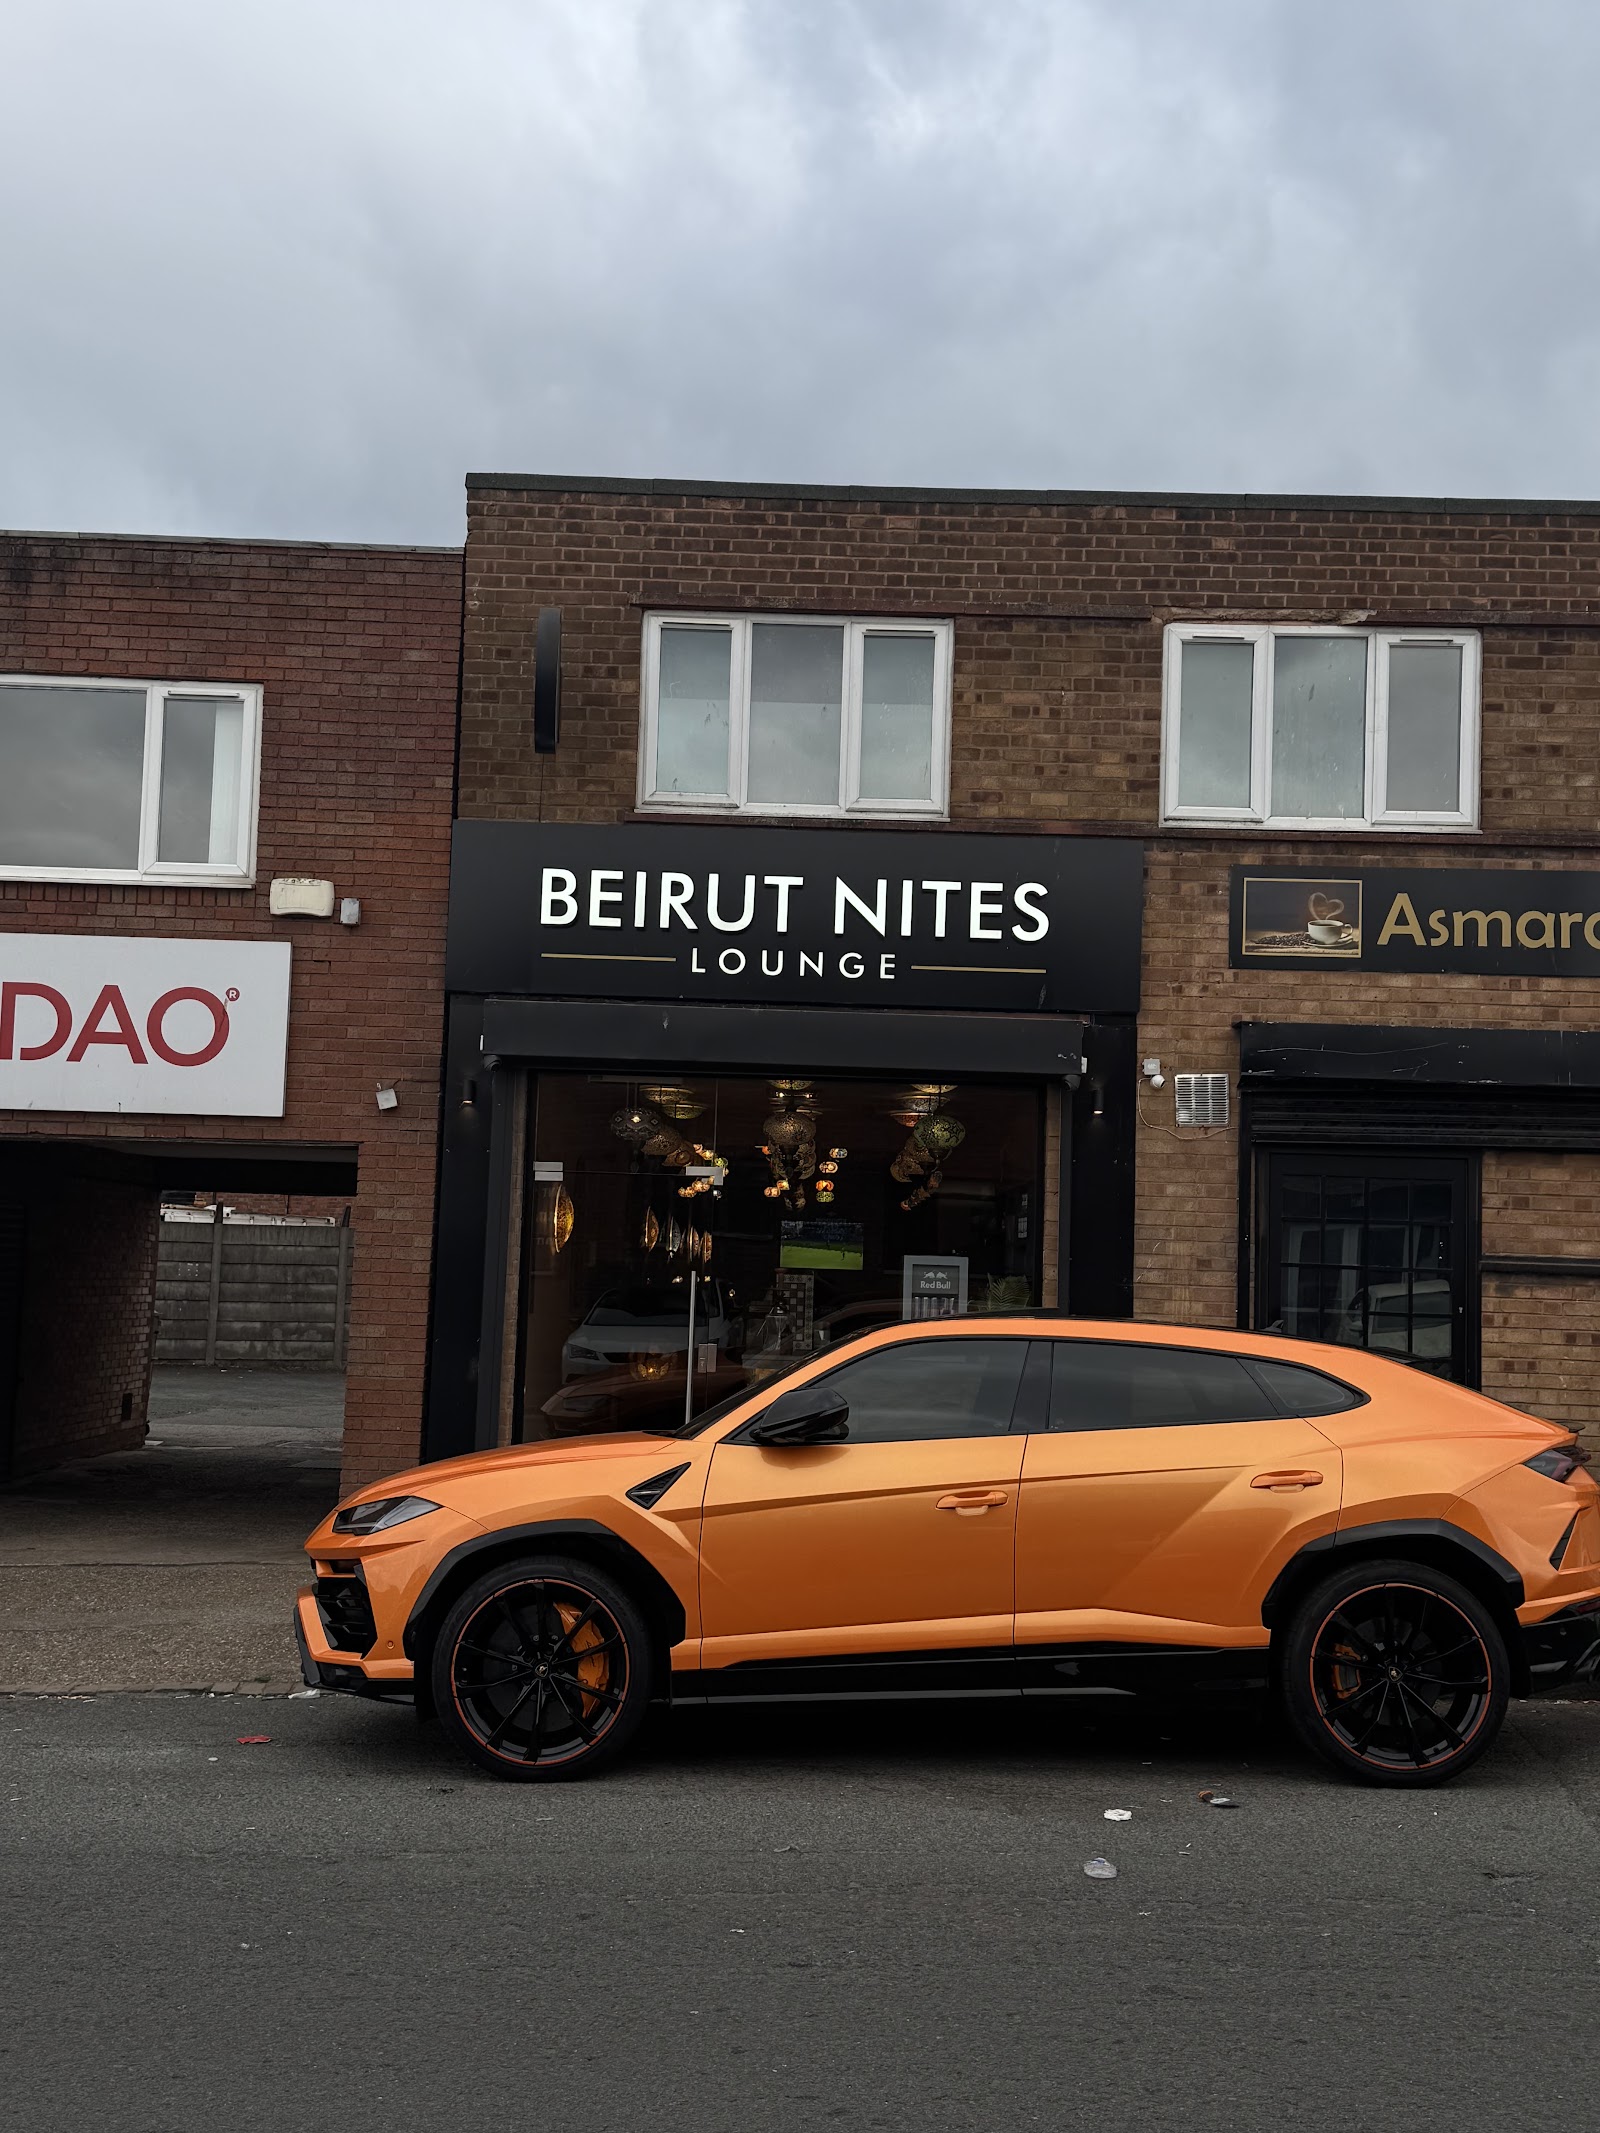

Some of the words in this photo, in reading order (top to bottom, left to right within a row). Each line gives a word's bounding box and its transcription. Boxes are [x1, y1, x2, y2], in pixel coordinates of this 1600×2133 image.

[540, 867, 804, 933] BEIRUT
[834, 876, 1050, 942] NITES
[691, 947, 896, 980] LOUNGE
[920, 1281, 935, 1289] Red
[936, 1281, 951, 1289] Bull
